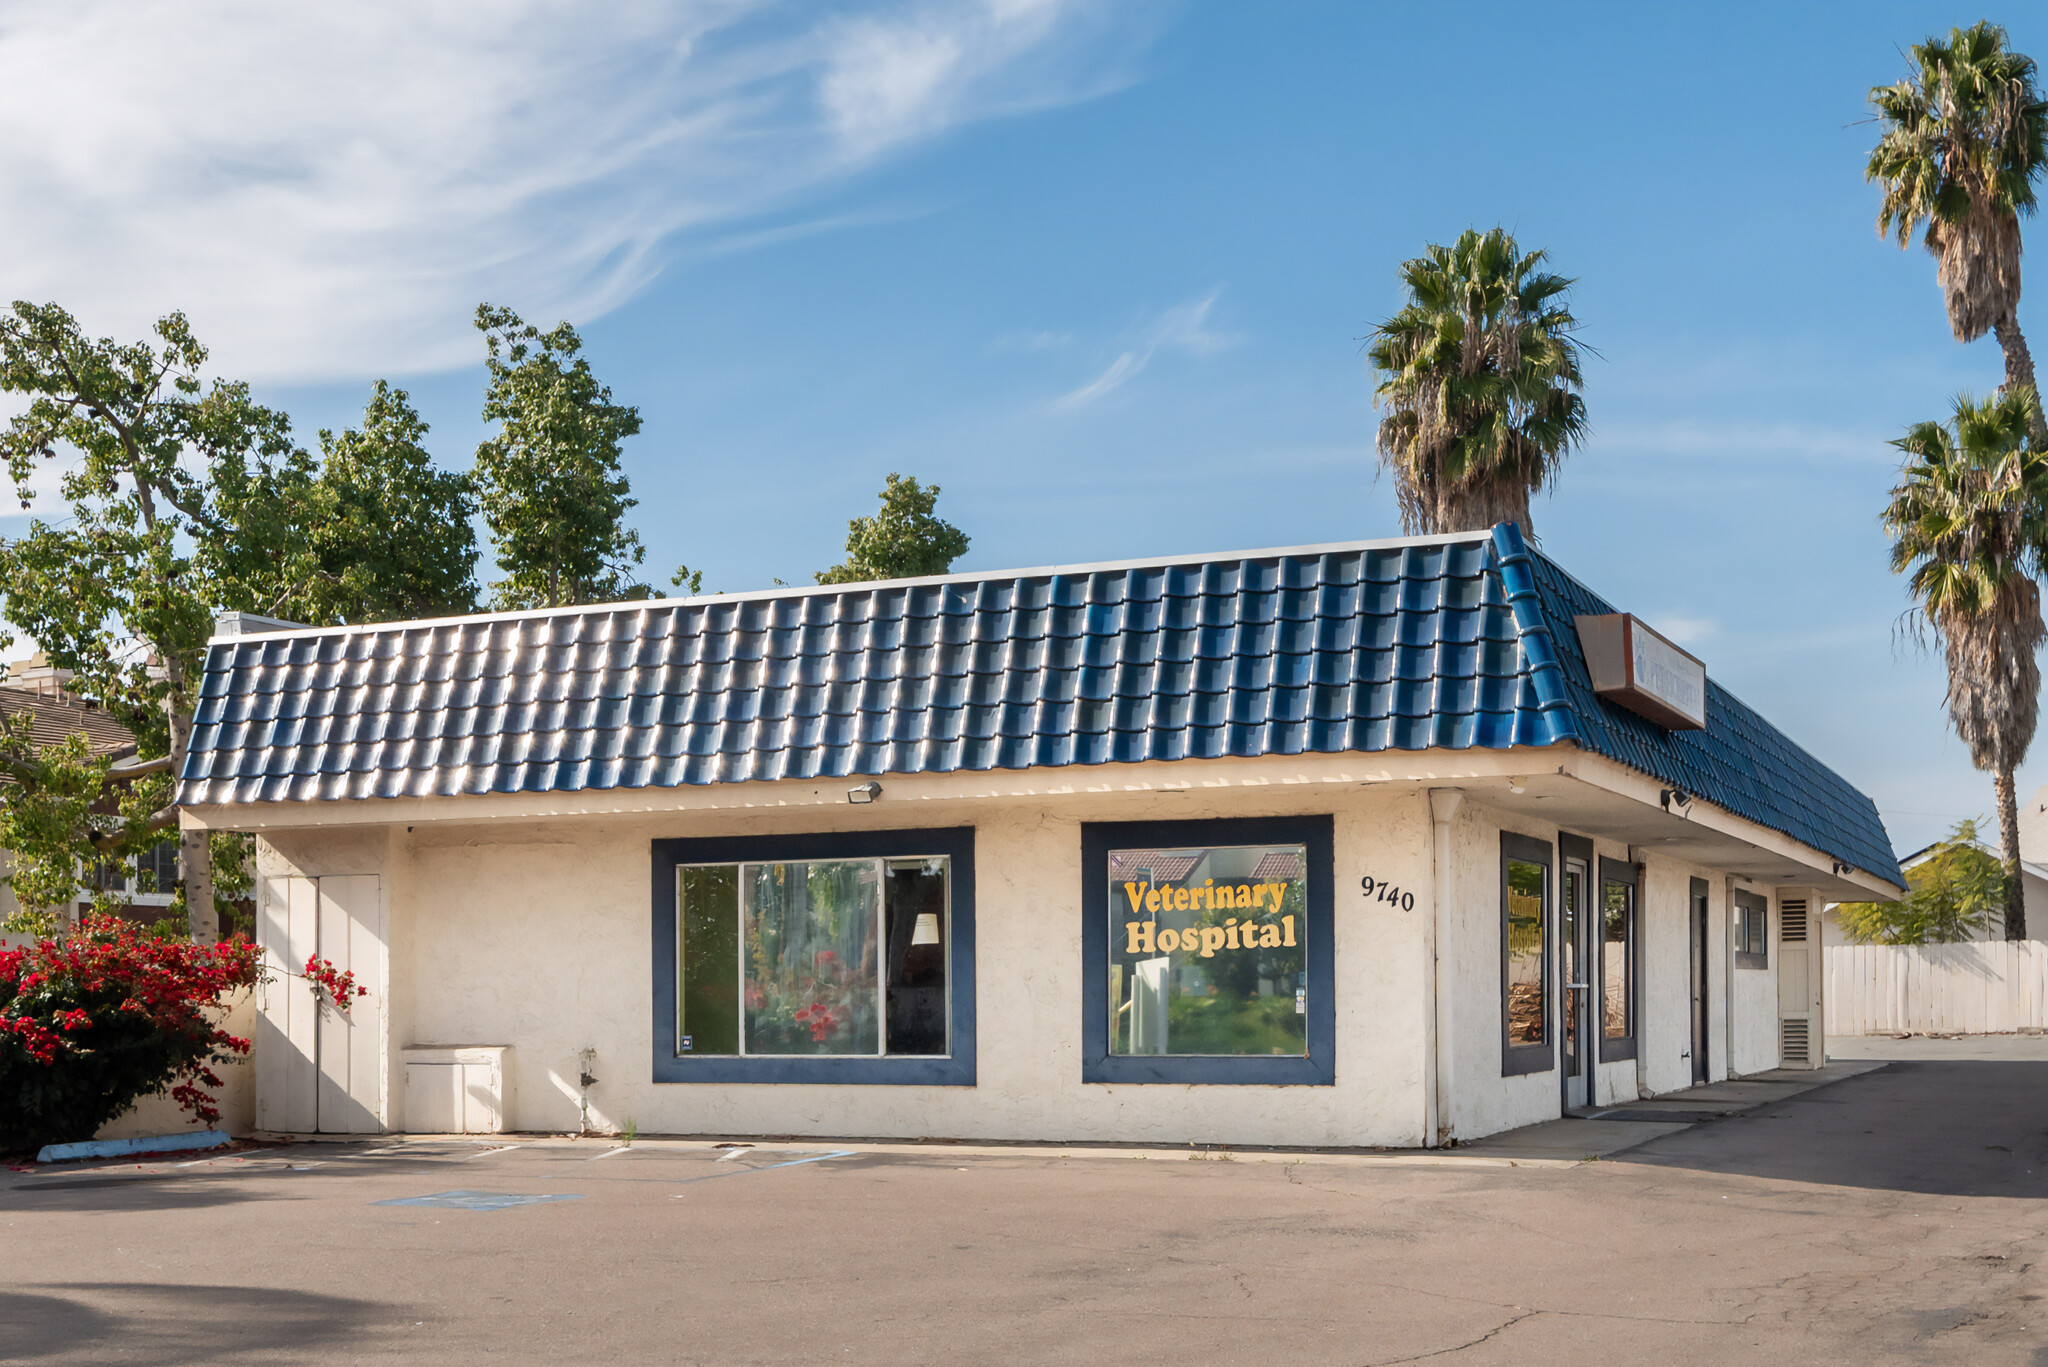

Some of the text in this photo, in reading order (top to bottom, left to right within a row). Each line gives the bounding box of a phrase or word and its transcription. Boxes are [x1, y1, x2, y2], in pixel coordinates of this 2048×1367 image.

[1124, 878, 1287, 913] Veterinary
[1361, 876, 1415, 912] 9740
[1126, 915, 1297, 957] Hospital
